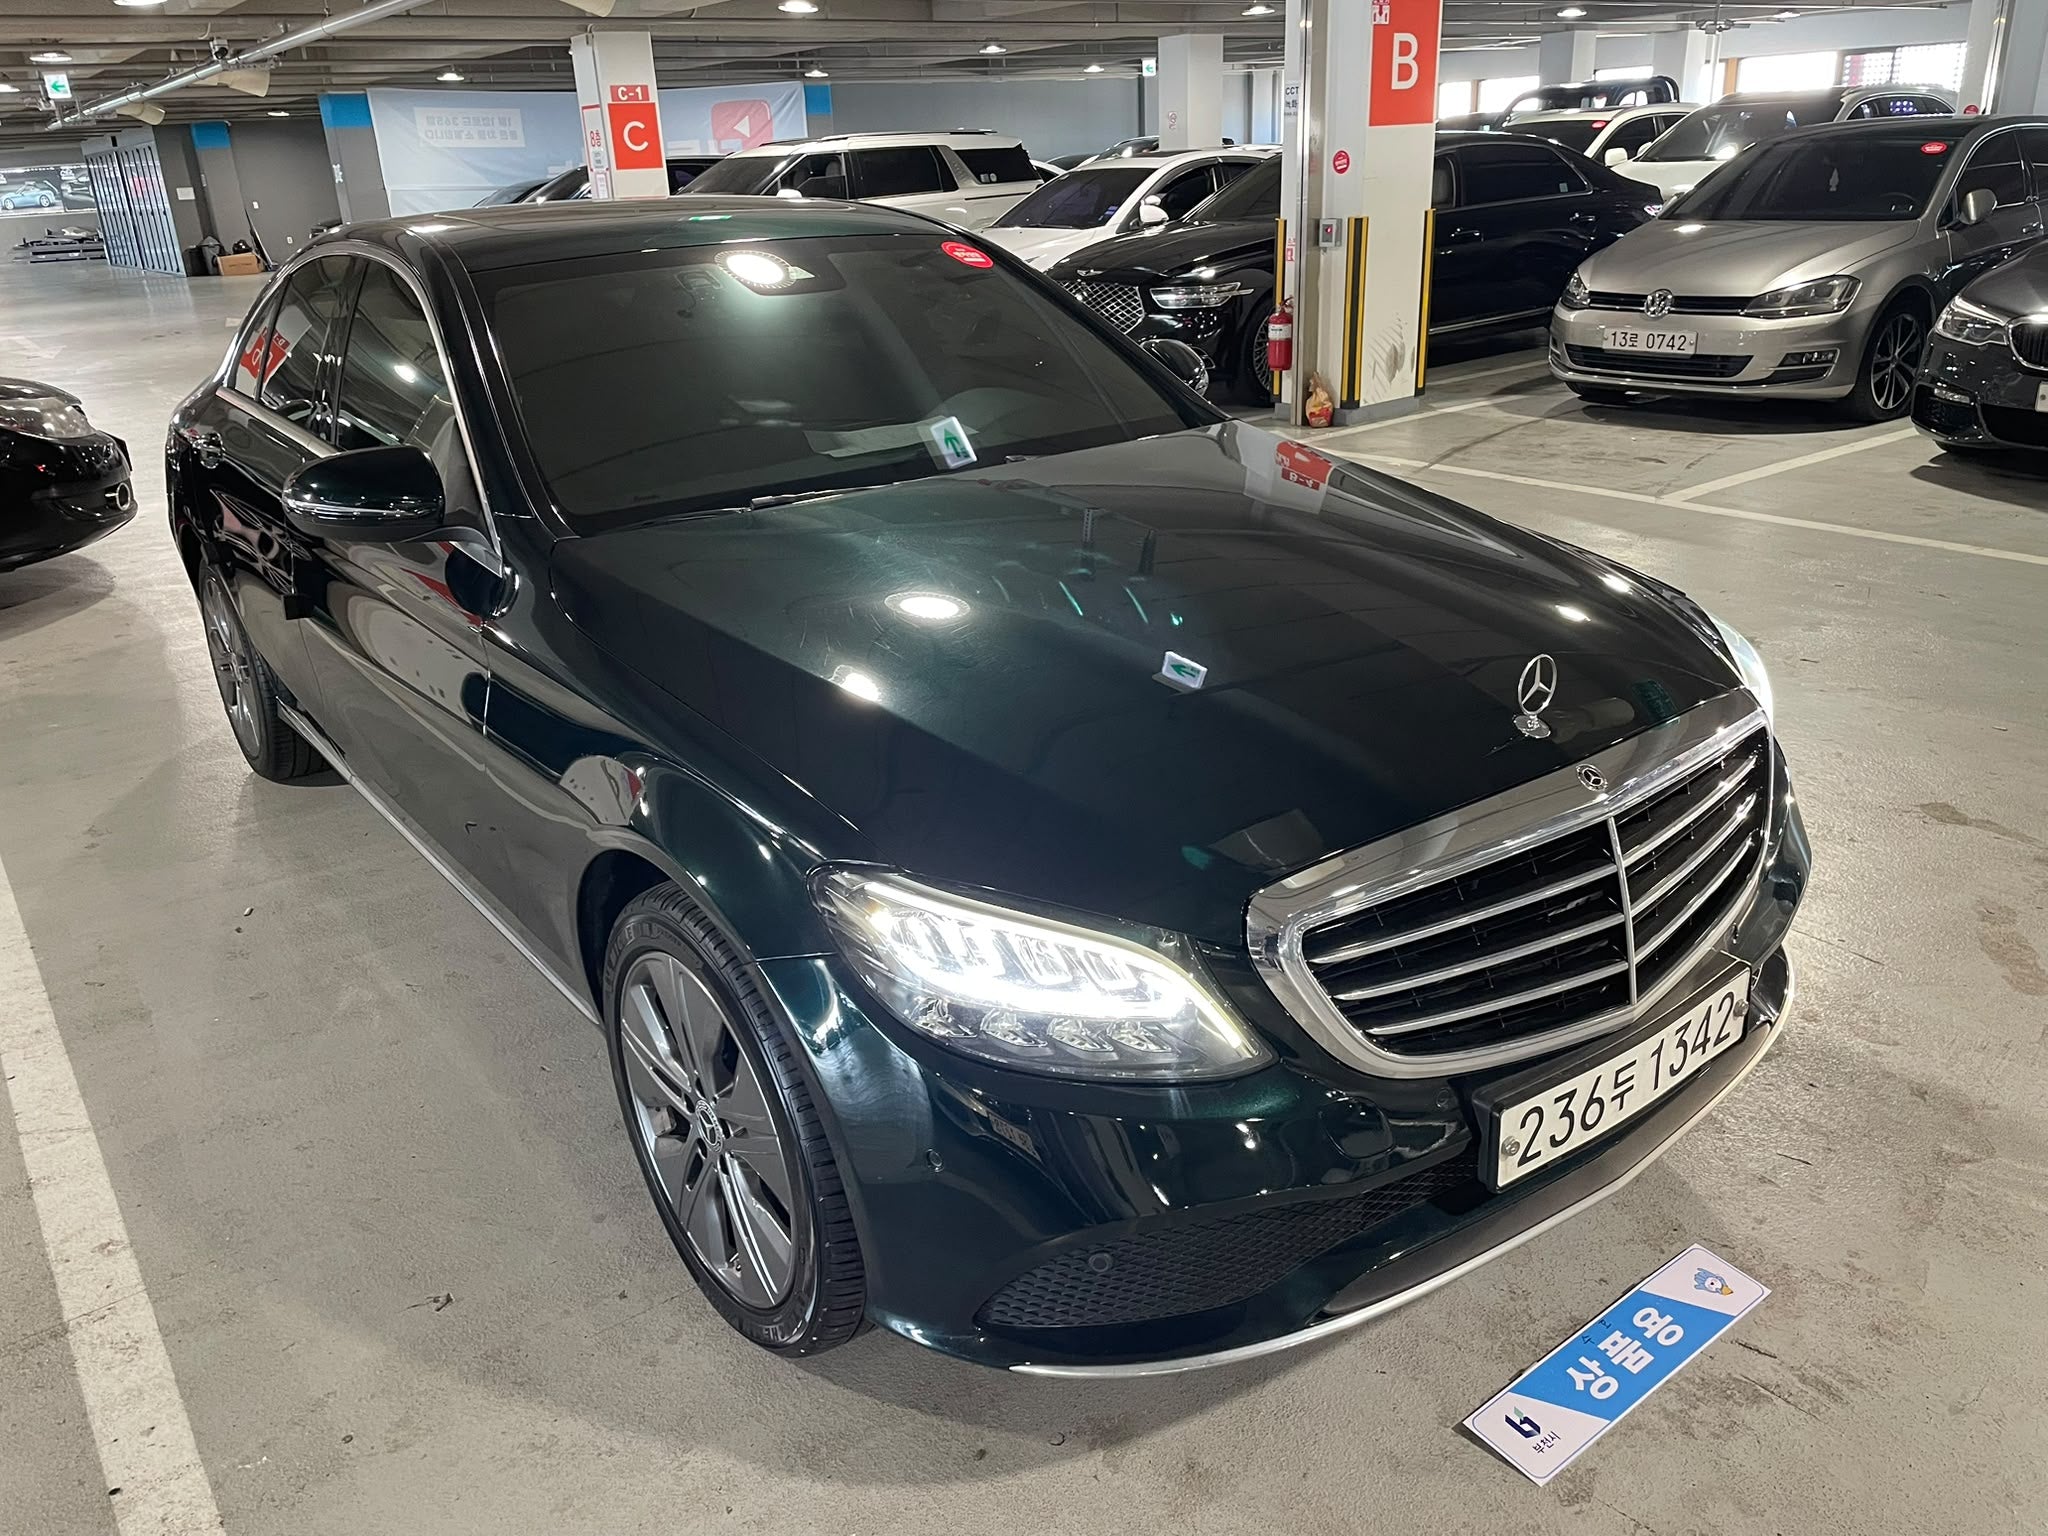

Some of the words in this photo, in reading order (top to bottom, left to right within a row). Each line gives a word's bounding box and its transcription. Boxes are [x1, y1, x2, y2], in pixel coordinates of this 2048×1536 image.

[1391, 32, 1419, 90] B
[617, 86, 643, 101] C-1
[1285, 86, 1299, 95] CCT
[623, 121, 649, 152] C
[1611, 331, 1639, 348] 13로
[1646, 333, 1687, 351] 0742
[1517, 1059, 1638, 1168] 236두
[1650, 991, 1735, 1091] 1342
[1565, 1306, 1684, 1400] 상품용
[1532, 1431, 1561, 1454] 부천시
